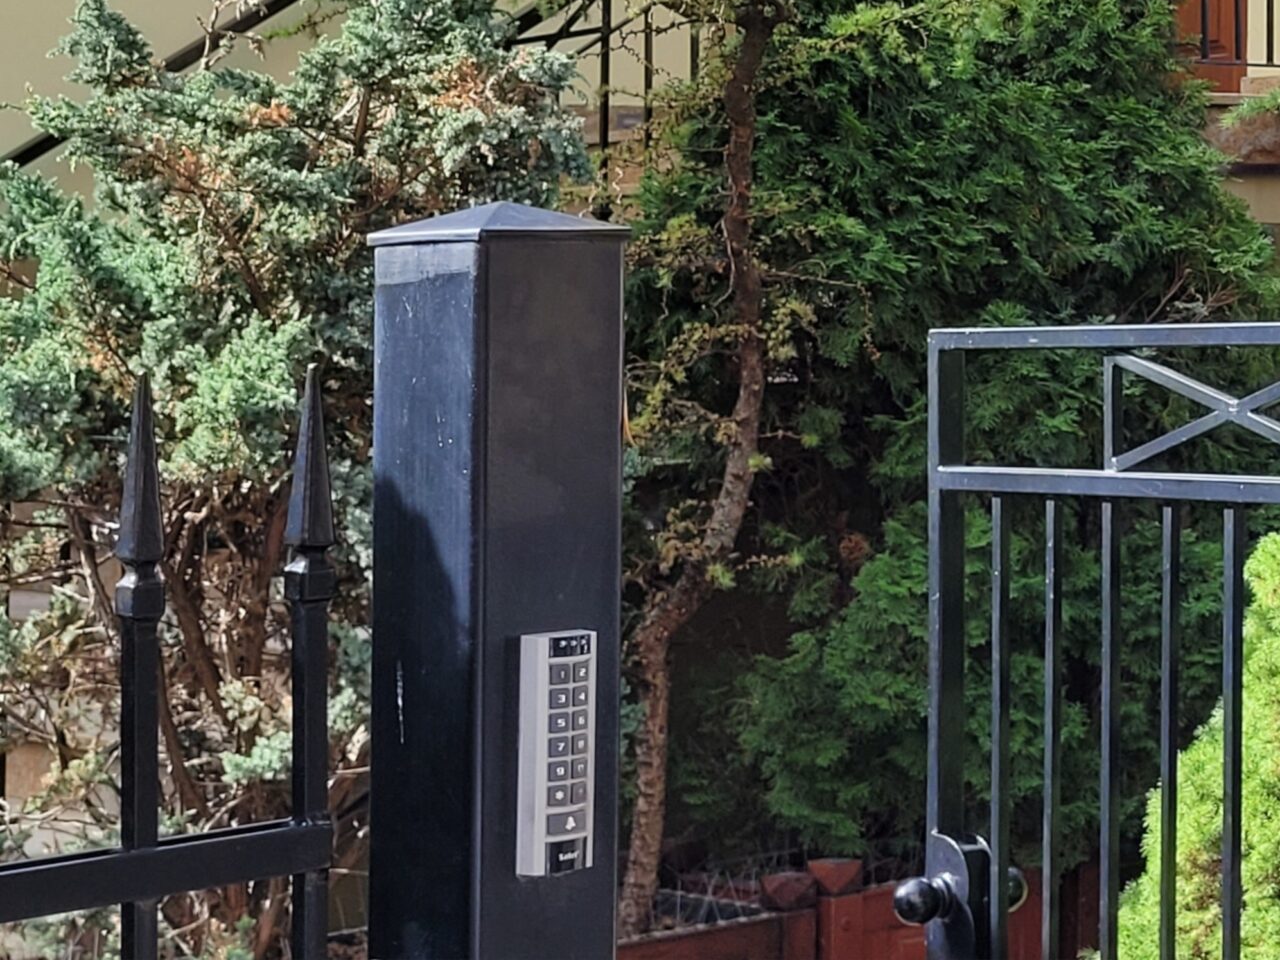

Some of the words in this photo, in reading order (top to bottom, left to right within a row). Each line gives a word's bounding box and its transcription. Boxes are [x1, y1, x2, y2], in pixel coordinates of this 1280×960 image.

[579, 667, 586, 677] 2
[557, 694, 566, 703] 3
[578, 692, 586, 700] 4
[557, 718, 566, 727] 5
[578, 715, 585, 725] 6
[557, 742, 566, 751] 7
[556, 766, 565, 776] 9
